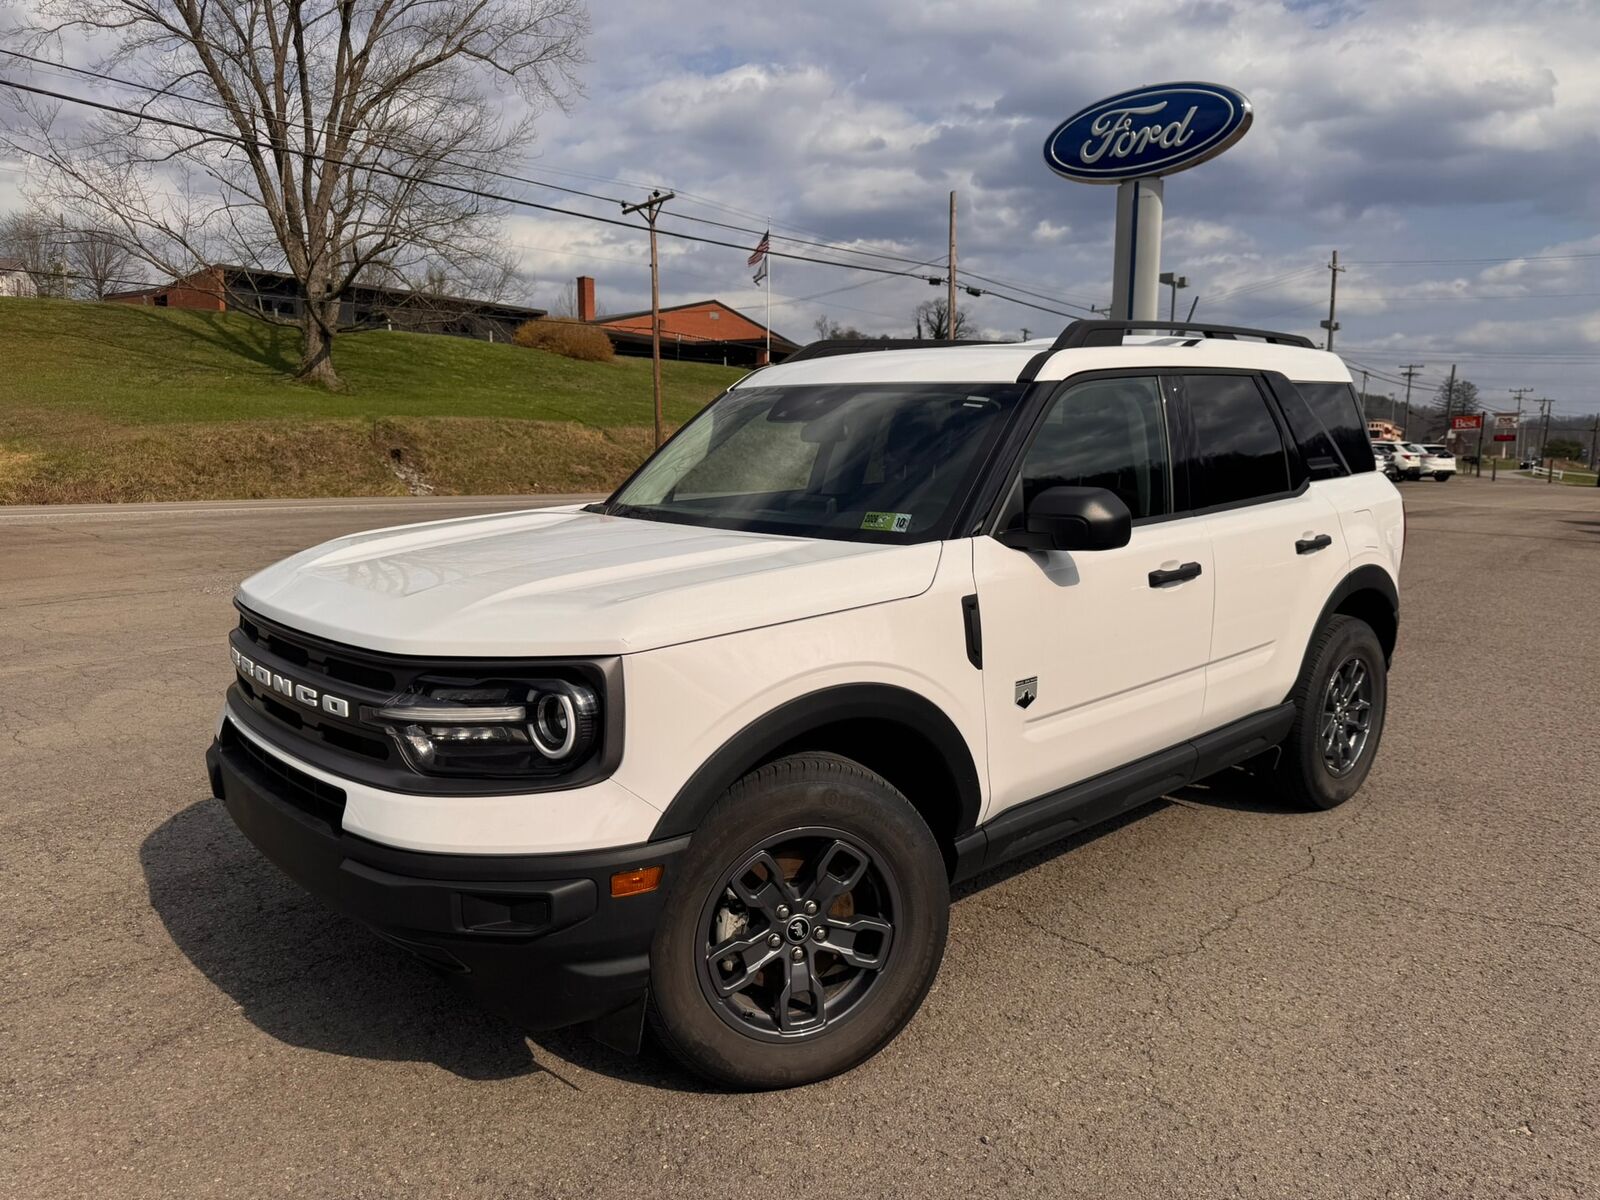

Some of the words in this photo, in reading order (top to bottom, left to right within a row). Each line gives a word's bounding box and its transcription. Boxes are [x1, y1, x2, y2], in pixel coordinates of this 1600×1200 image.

[1080, 101, 1198, 164] Ford
[1455, 418, 1477, 429] Best
[896, 517, 906, 528] 10
